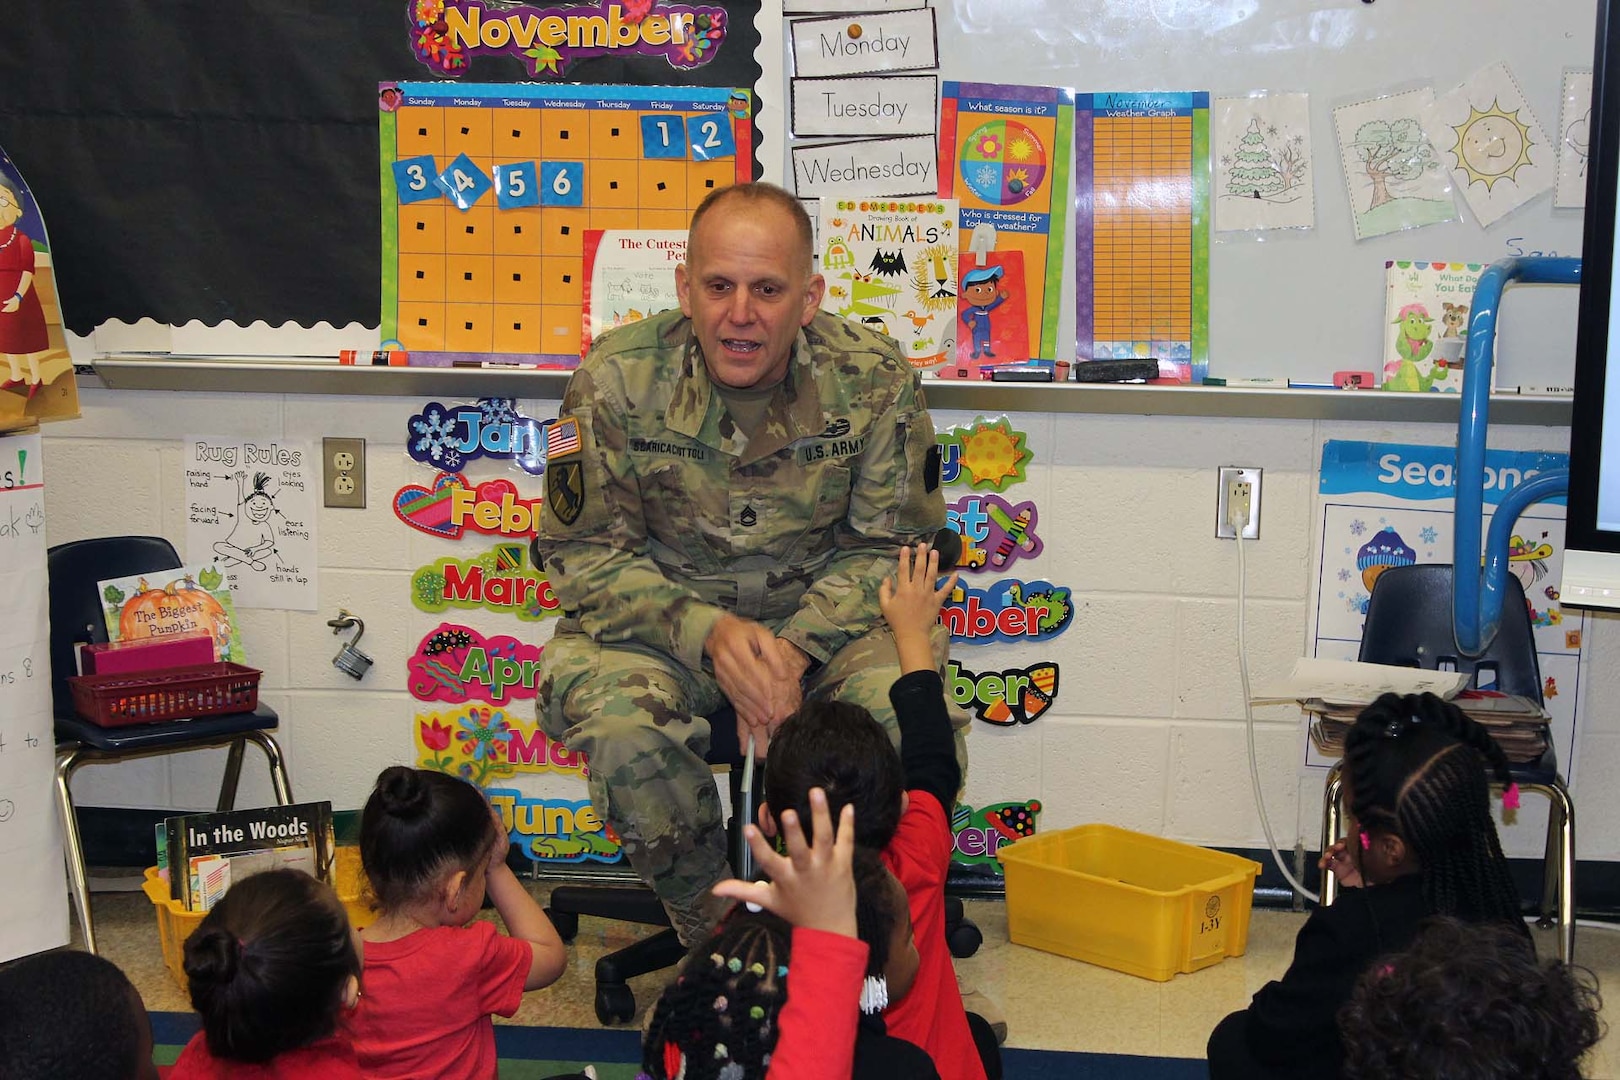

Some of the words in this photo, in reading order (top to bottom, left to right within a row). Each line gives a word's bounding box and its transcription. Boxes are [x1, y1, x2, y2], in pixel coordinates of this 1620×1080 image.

[445, 4, 695, 49] November
[820, 27, 910, 58] Monday
[408, 98, 436, 107] Sunday
[453, 98, 482, 108] Monday
[502, 98, 531, 109] Tuesday
[544, 99, 586, 110] Wednesday
[597, 100, 630, 111] Thursday
[651, 101, 673, 111] Friday
[692, 102, 725, 113] Saturday
[821, 91, 908, 124] Tuesday
[1105, 93, 1172, 109] November
[968, 102, 992, 112] What
[995, 104, 1023, 113] season
[1025, 105, 1032, 114] is
[1034, 105, 1047, 115] it?
[1106, 109, 1145, 118] Weather
[1148, 109, 1177, 119] Graph
[656, 121, 670, 148] 1
[701, 120, 722, 148] 2
[968, 127, 988, 143] Spring
[1023, 127, 1043, 152] Summer
[802, 151, 931, 184] Wednesday
[406, 164, 427, 192] 3
[453, 168, 475, 193] 4
[508, 169, 526, 198] 5
[552, 171, 571, 196] 6
[964, 177, 983, 198] Winter
[1025, 187, 1036, 198] Fall
[838, 201, 855, 211] ED
[868, 214, 892, 223] Drawing
[895, 214, 908, 222] Book
[961, 209, 982, 218] Who
[984, 210, 991, 219] is
[993, 211, 1026, 221] dressed
[1029, 213, 1042, 222] for
[847, 223, 939, 243] ANIMALS
[997, 221, 1037, 231] weather?
[618, 239, 642, 250] The
[646, 239, 688, 250] Cutest
[1439, 273, 1461, 283] What
[1434, 284, 1455, 293] You
[195, 441, 238, 467] Rug
[244, 443, 302, 467] Rules
[805, 445, 829, 462] U.S.
[831, 438, 865, 458] ARMY
[186, 470, 211, 480] raising
[283, 470, 301, 479] eyes
[190, 478, 209, 487] hand
[278, 477, 304, 491] looking
[190, 503, 217, 516] facing
[189, 514, 219, 525] forward
[278, 527, 309, 540] listening
[276, 563, 299, 573] hands
[286, 575, 293, 583] in
[295, 576, 308, 586] lap
[134, 610, 156, 623] The
[158, 602, 204, 619] Biggest
[149, 619, 198, 636] Pumpkin
[24, 731, 39, 748] to
[491, 795, 604, 835] June
[189, 827, 208, 847] In
[213, 824, 244, 844] the
[249, 816, 309, 841] Woods
